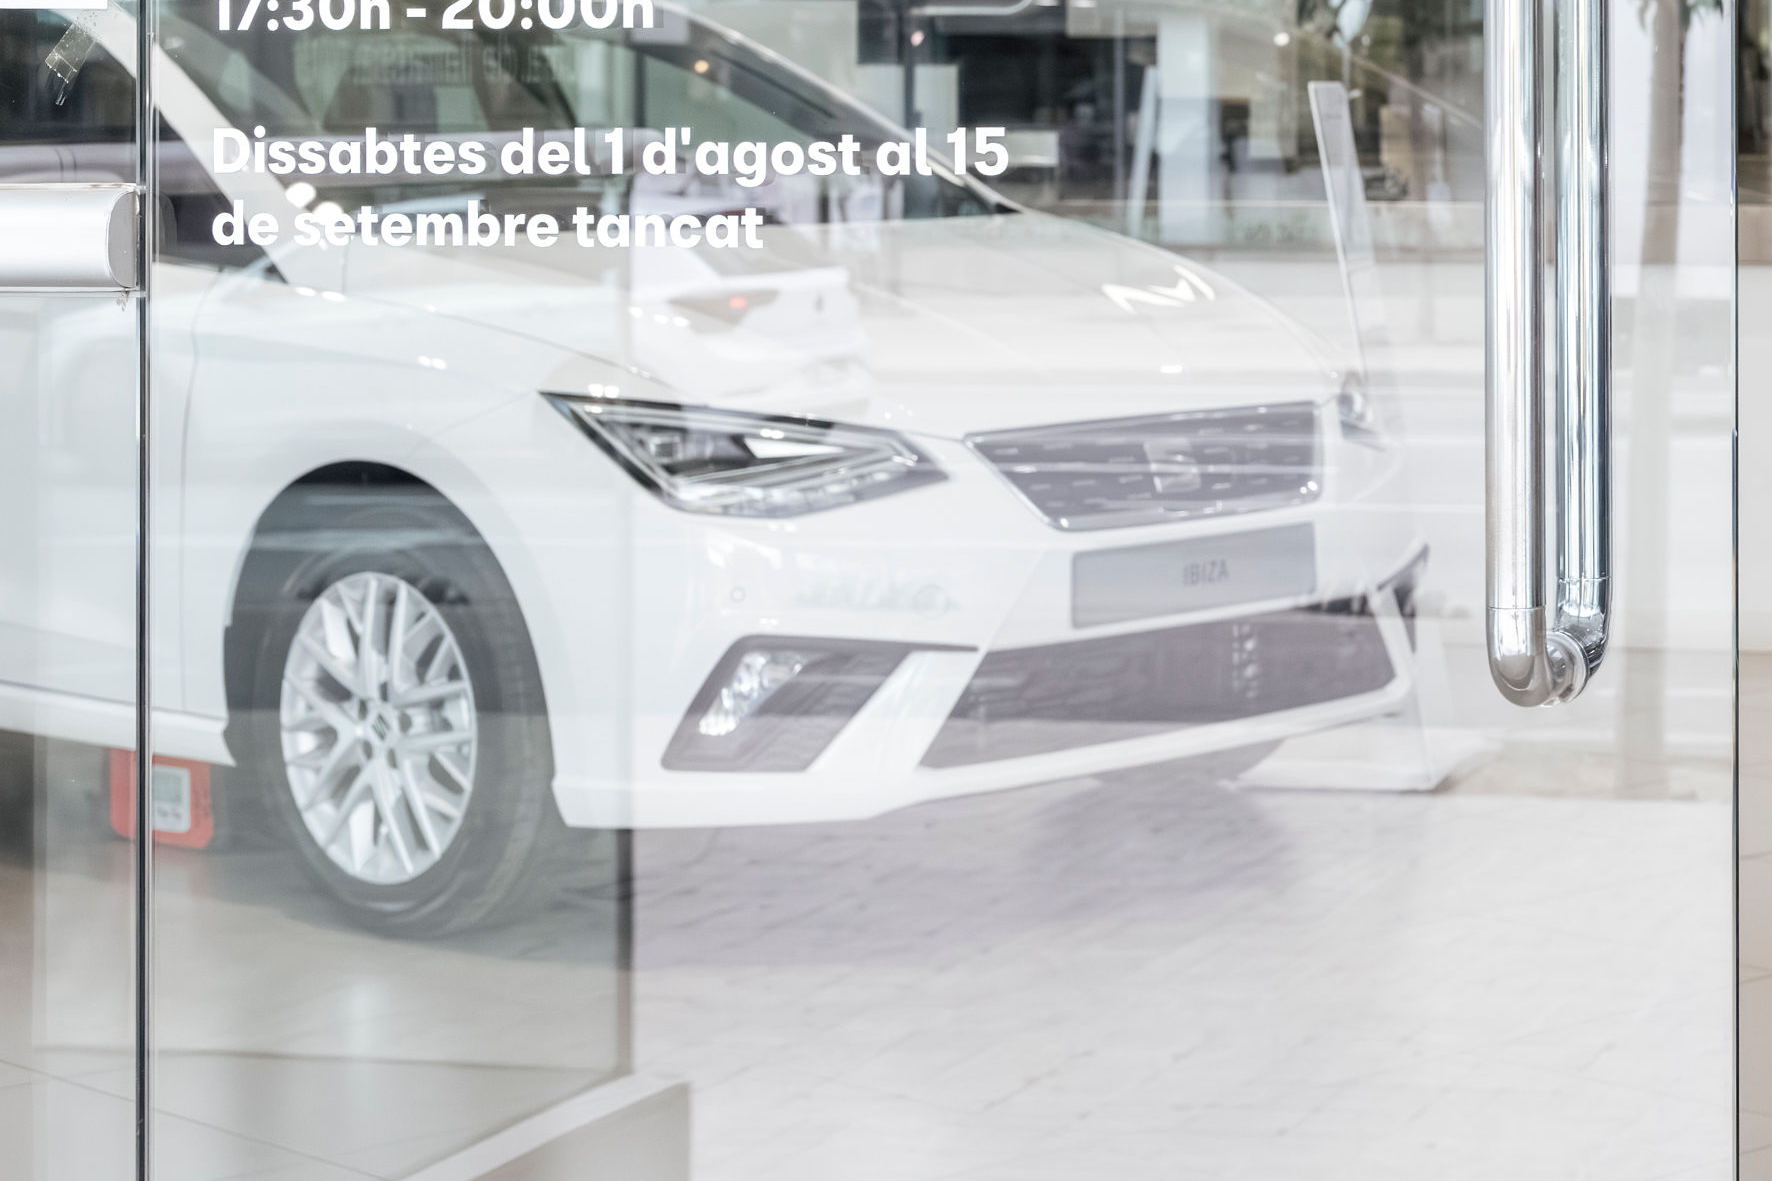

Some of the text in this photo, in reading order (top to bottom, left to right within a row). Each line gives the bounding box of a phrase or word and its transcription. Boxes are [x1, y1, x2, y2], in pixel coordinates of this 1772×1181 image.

[405, 7, 427, 19] -
[213, 126, 1009, 188] Dissabtes del 1 d'agost al 15
[212, 199, 764, 249] de setembre tancat
